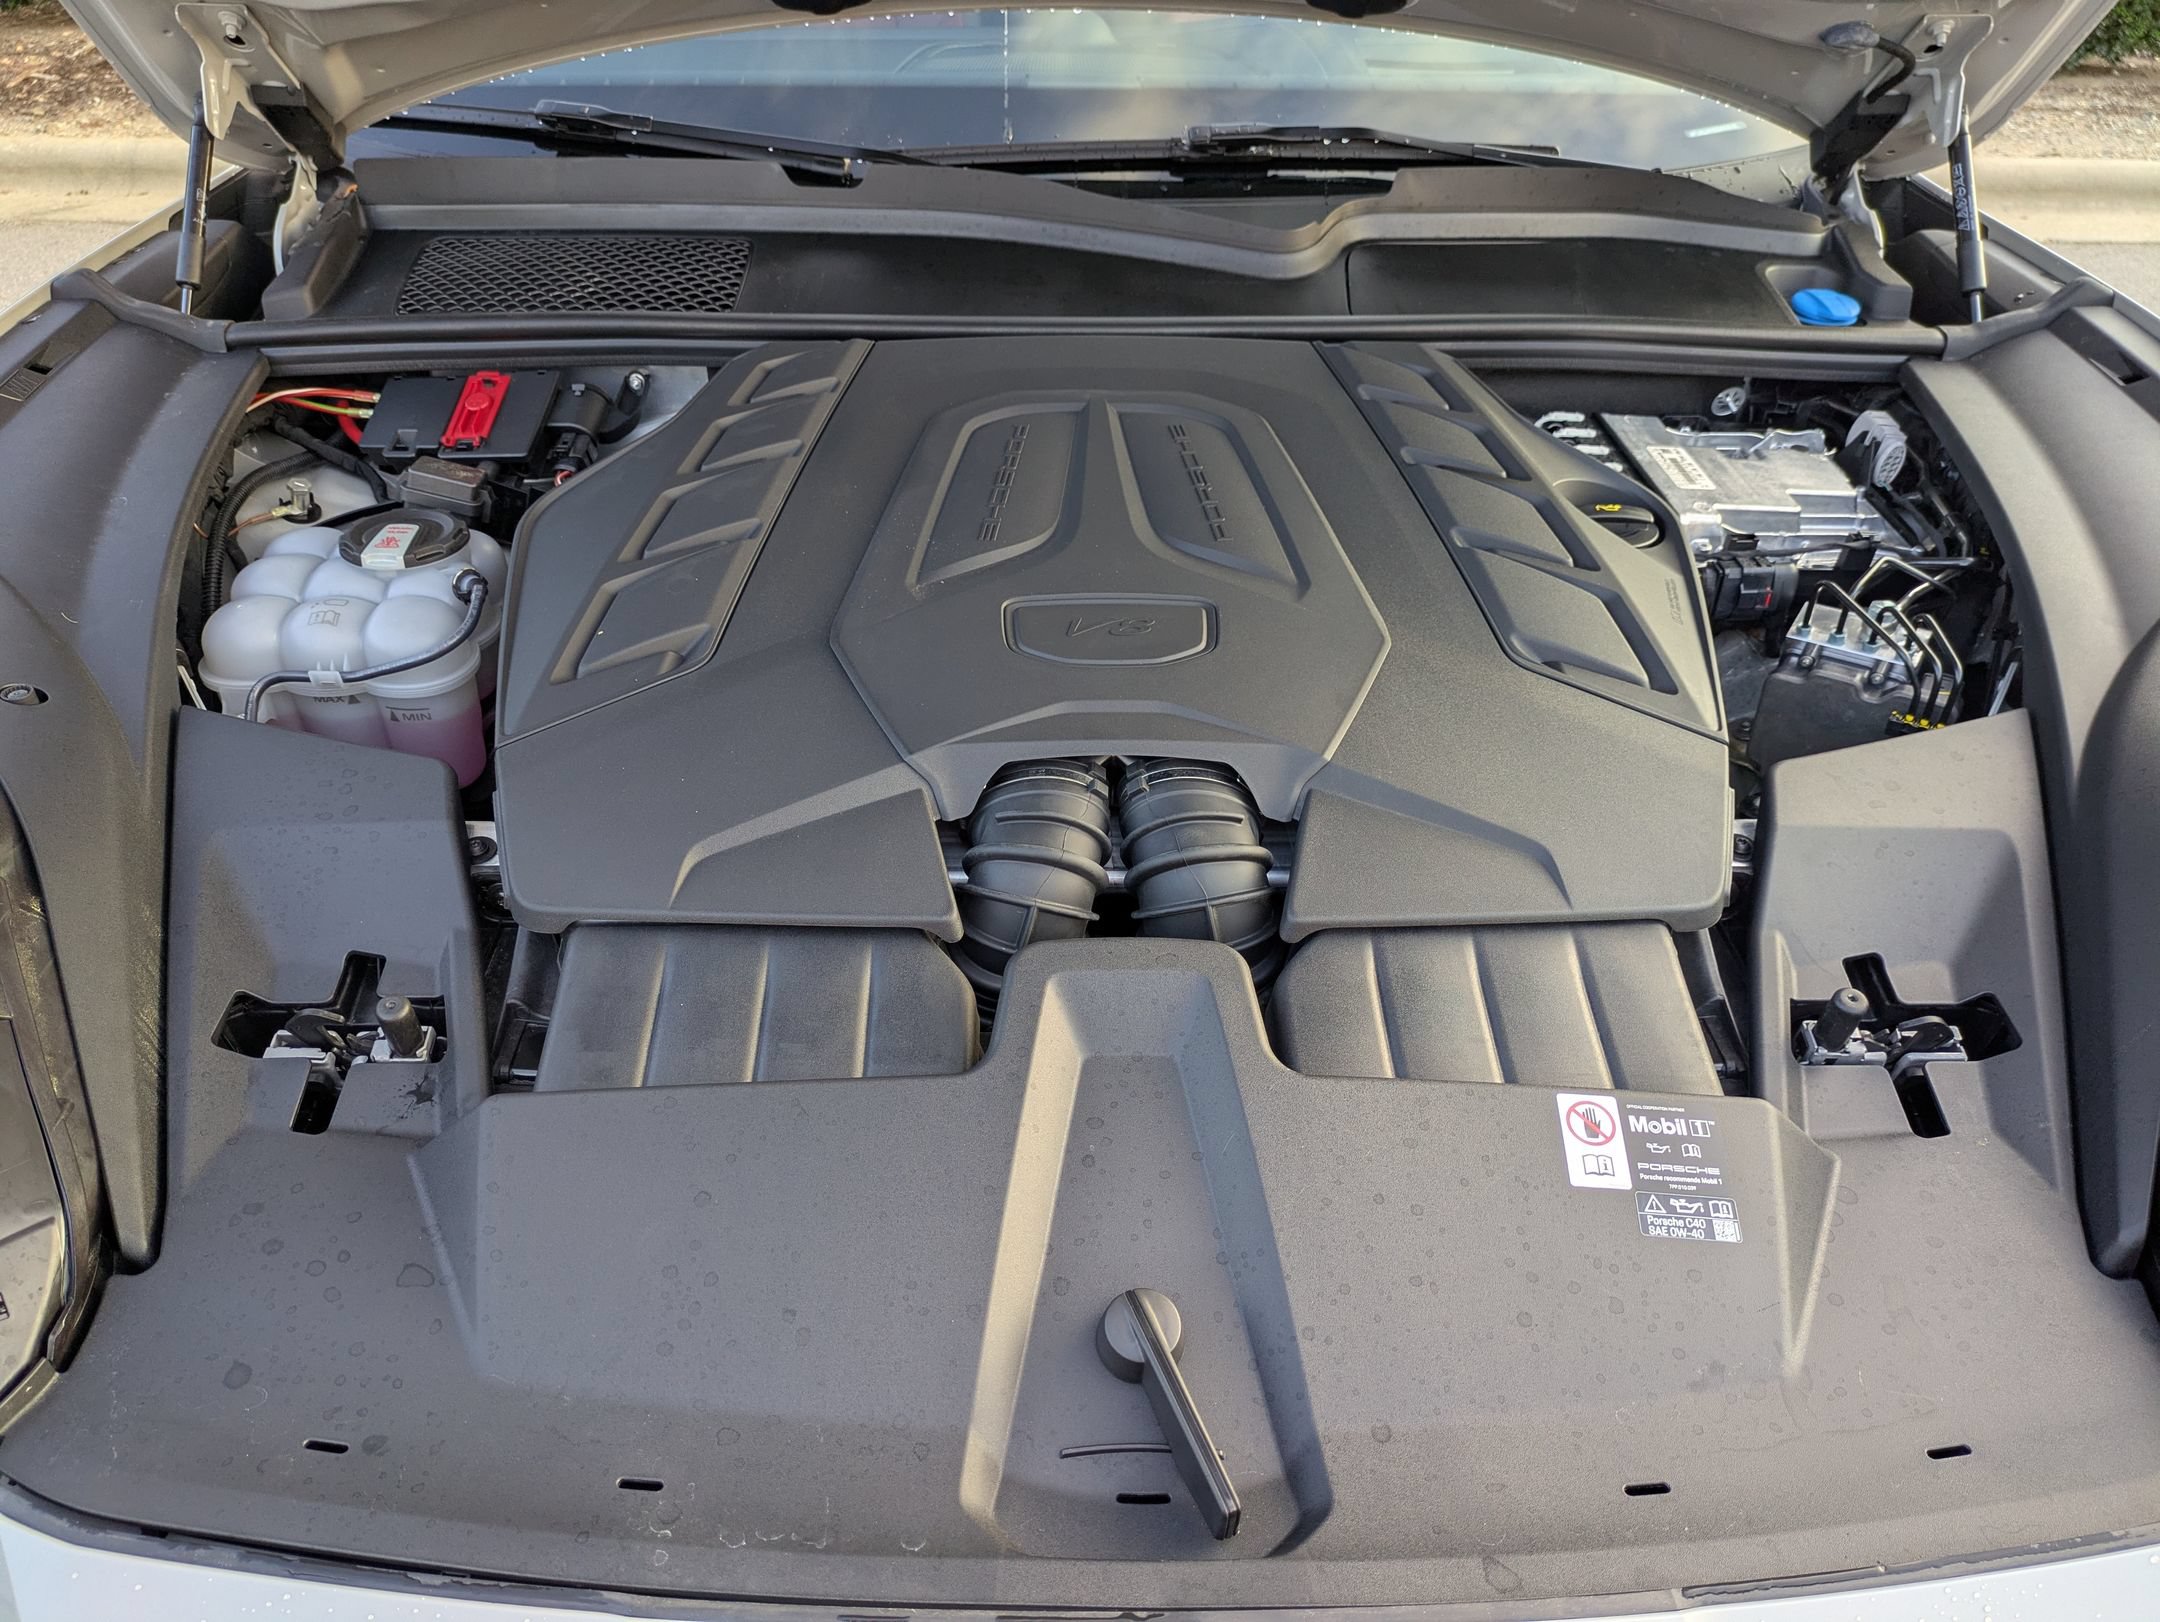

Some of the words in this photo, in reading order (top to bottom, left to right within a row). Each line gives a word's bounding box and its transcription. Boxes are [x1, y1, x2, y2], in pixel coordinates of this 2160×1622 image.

[977, 424, 1030, 541] PORSCHE
[1167, 424, 1233, 541] PORSCHE
[1065, 617, 1156, 637] V8
[402, 712, 432, 721] MIN
[1628, 1115, 1688, 1136] Mobil
[1637, 1162, 1720, 1175] PORSCHE
[1640, 1173, 1663, 1181] Porsche
[1664, 1174, 1700, 1184] recommends
[1701, 1177, 1718, 1185] Mobil
[1647, 1215, 1684, 1227] Porsche
[1685, 1218, 1706, 1229] C40
[1648, 1225, 1669, 1236] SAE
[1670, 1227, 1705, 1239] 0W-40
